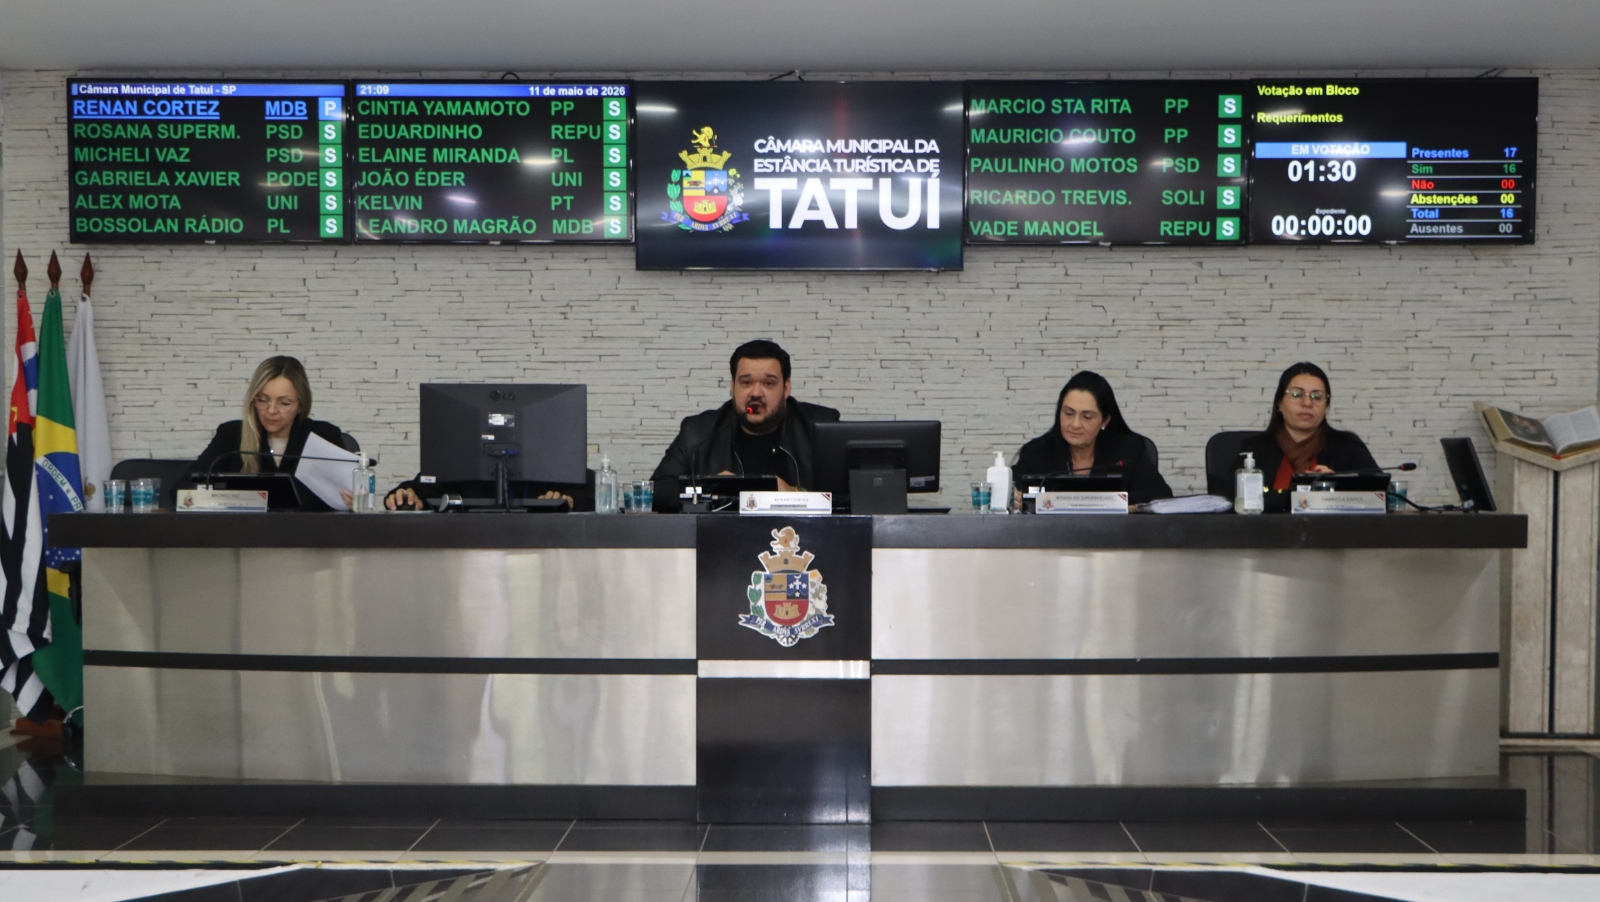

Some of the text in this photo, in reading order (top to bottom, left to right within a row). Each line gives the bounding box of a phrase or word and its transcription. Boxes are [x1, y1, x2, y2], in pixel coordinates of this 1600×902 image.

[79, 84, 118, 94] Câmara
[121, 84, 170, 96] Municipal
[173, 85, 185, 94] de
[222, 86, 236, 94] SP
[360, 86, 389, 95] 21:09
[529, 86, 625, 96] 11 de maio de 2026
[1258, 86, 1359, 97] Votação em Bloco
[73, 100, 336, 116] RENAN CORTEZ MDB P
[358, 101, 620, 116] CINTIA YAMAMOTO PP S
[970, 99, 1236, 114] MARCIO STA RITA PP S
[1257, 113, 1343, 124] Requerimentos
[74, 124, 336, 139] ROSANA SUPERM. PSD S
[358, 125, 620, 139] EDUARDINHO REPU S
[970, 128, 1236, 143] MAURICIO COUTO PP S
[754, 136, 940, 154] CÂMARA MUNICIPAL DA
[1292, 143, 1370, 157] EM VOTAÇÃO
[74, 148, 336, 163] MICHELI VAZ PSD S
[358, 148, 621, 163] ELAINE MIRANDA PL S
[1412, 148, 1517, 158] Presentes 17
[754, 156, 940, 173] ESTÂNCIA TURÍSTICA DE
[970, 158, 1235, 173] PAULINHO MOTOS PSD S
[1288, 160, 1356, 182] 01:30
[1412, 164, 1516, 174] Sim 16
[75, 171, 336, 186] GABRIELA XAVIER PODE S
[358, 168, 621, 186] JOÃO ÉDER UNI S
[1411, 179, 1515, 189] Não 00
[75, 195, 337, 210] ALEX MOTA UNI S
[358, 196, 621, 210] KELVIN PT S
[754, 172, 940, 230] TATUÍ
[970, 190, 1235, 205] RICARDO TREVIS. SOLI S
[1410, 194, 1514, 206] Abstenções 00
[1411, 209, 1513, 219] Total 16
[76, 215, 337, 233] BOSSOLAN RÁDIO PL S
[358, 216, 621, 234] LEANDRO MAGRÃO MDB S
[970, 221, 1234, 236] VADE MANOEL REPU S
[1272, 215, 1372, 236] 00:00:00
[1410, 224, 1512, 234] Ausentes 00
[42, 459, 67, 487] ORDEM
